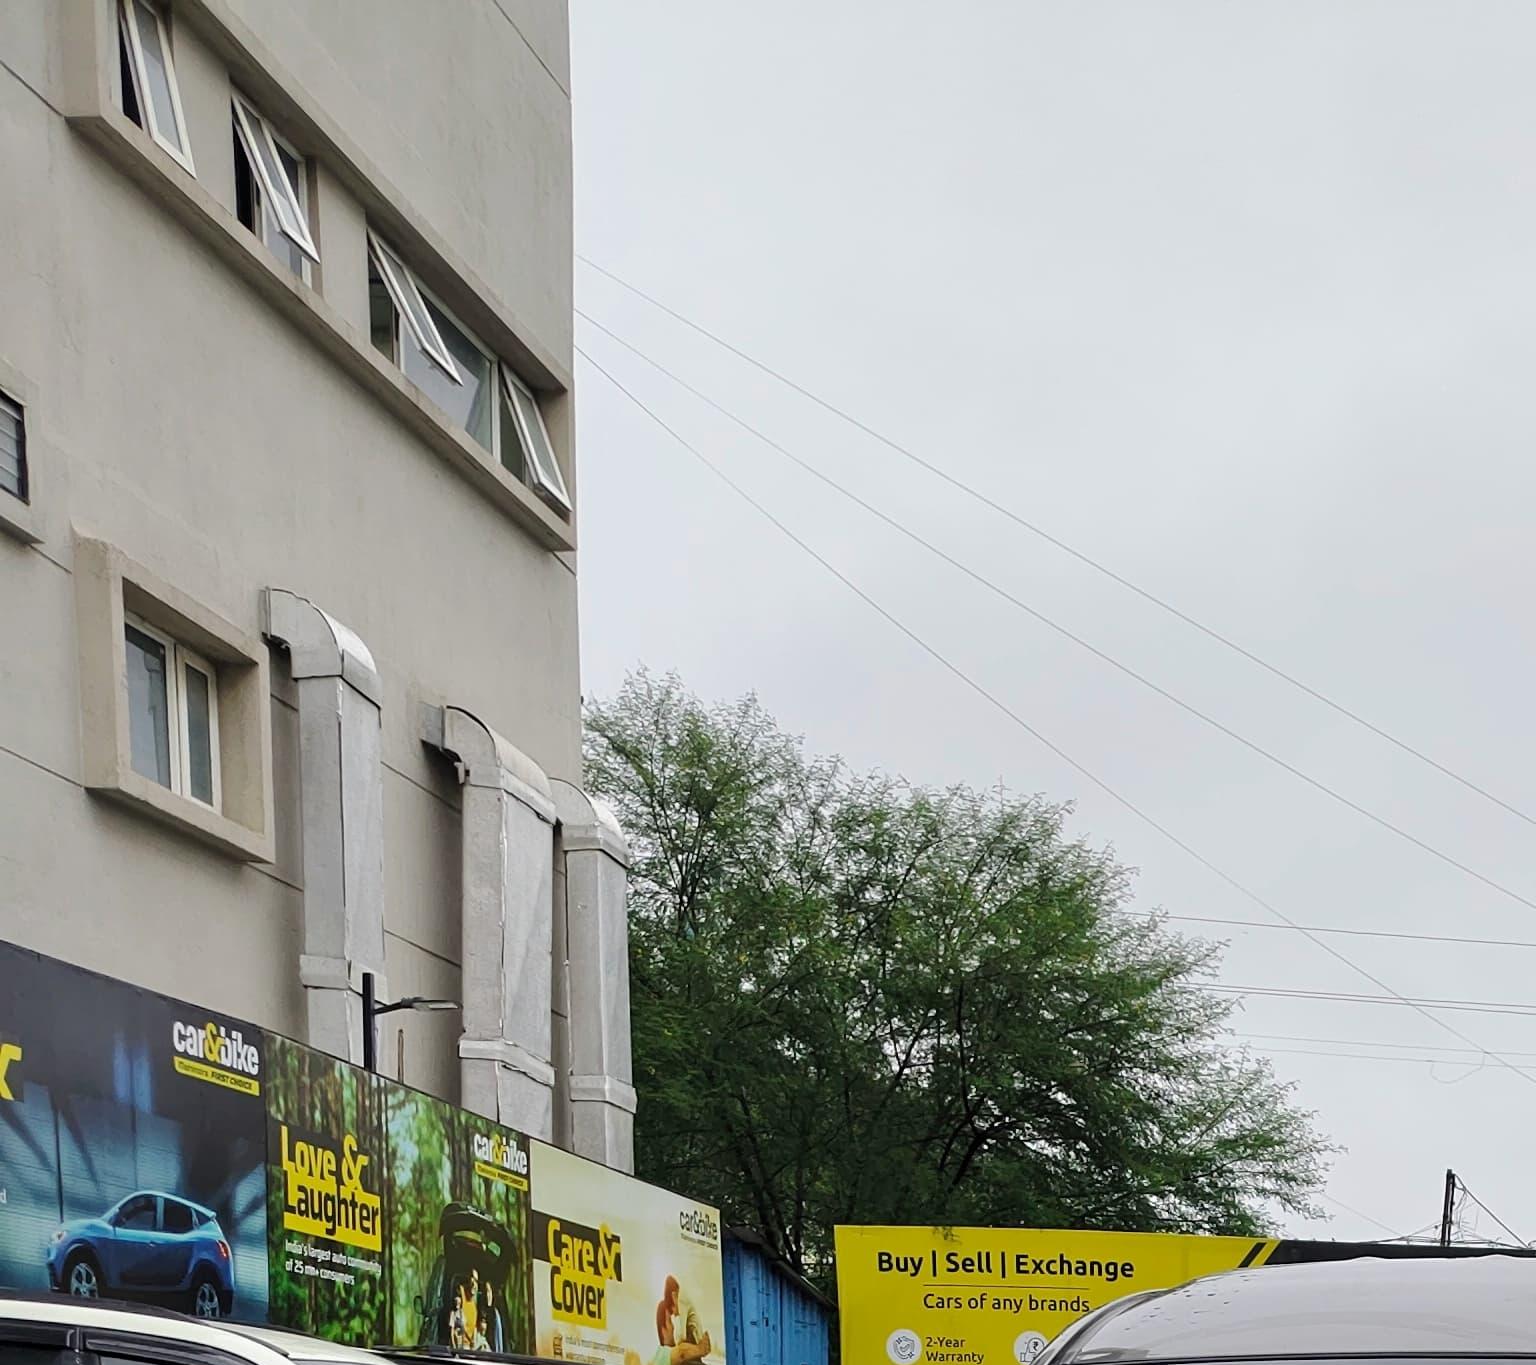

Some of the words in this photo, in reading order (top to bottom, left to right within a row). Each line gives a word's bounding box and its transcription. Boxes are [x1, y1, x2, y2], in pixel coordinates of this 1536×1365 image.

[173, 1021, 259, 1076] car&bike
[281, 1126, 337, 1181] Love
[342, 1134, 369, 1197] &
[474, 1134, 528, 1175] car&bike
[285, 1172, 379, 1236] Laughter
[548, 1219, 595, 1276] Care
[598, 1223, 621, 1281] &
[877, 1251, 923, 1276] Buy
[946, 1252, 992, 1273] Sell
[1015, 1253, 1134, 1282] Exchange
[551, 1265, 604, 1320] Cover
[923, 1293, 962, 1310] Cars
[967, 1293, 988, 1309] of
[991, 1298, 1023, 1314] any
[1028, 1296, 1091, 1313] brands
[925, 1337, 966, 1349] 2-Year
[926, 1352, 985, 1365] Warranty
